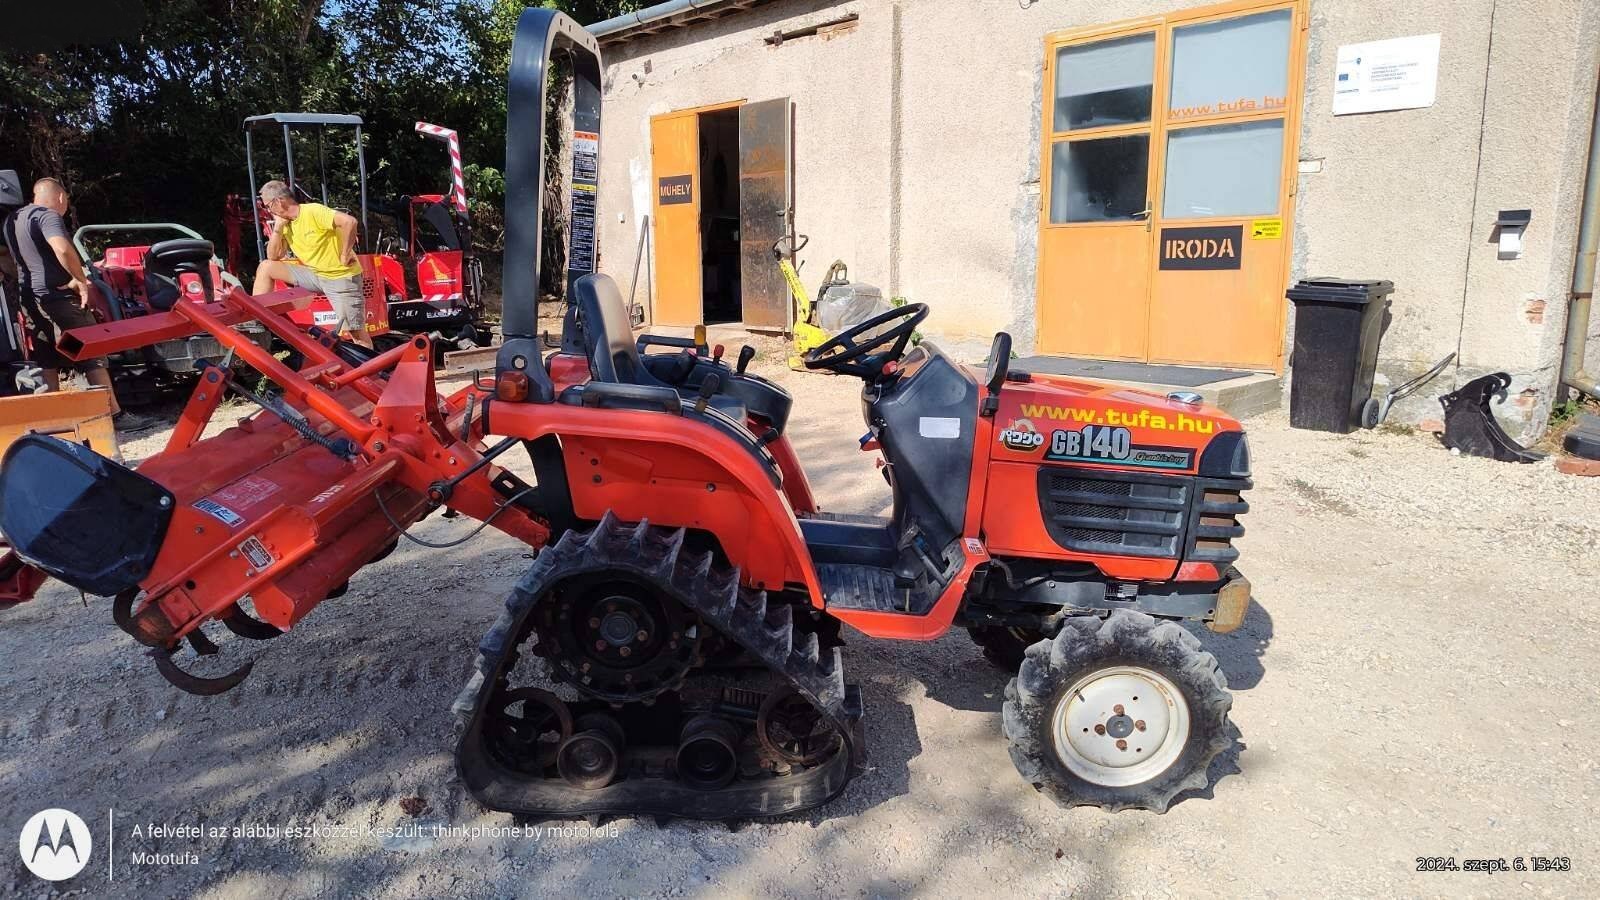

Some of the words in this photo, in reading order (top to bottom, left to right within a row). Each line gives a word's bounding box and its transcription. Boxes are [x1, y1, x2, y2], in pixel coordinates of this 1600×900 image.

[1167, 95, 1287, 118] www.tufa.hu
[1165, 238, 1235, 259] IRODA
[1020, 403, 1213, 434] www.tufa.hu
[1050, 424, 1131, 460] GB140
